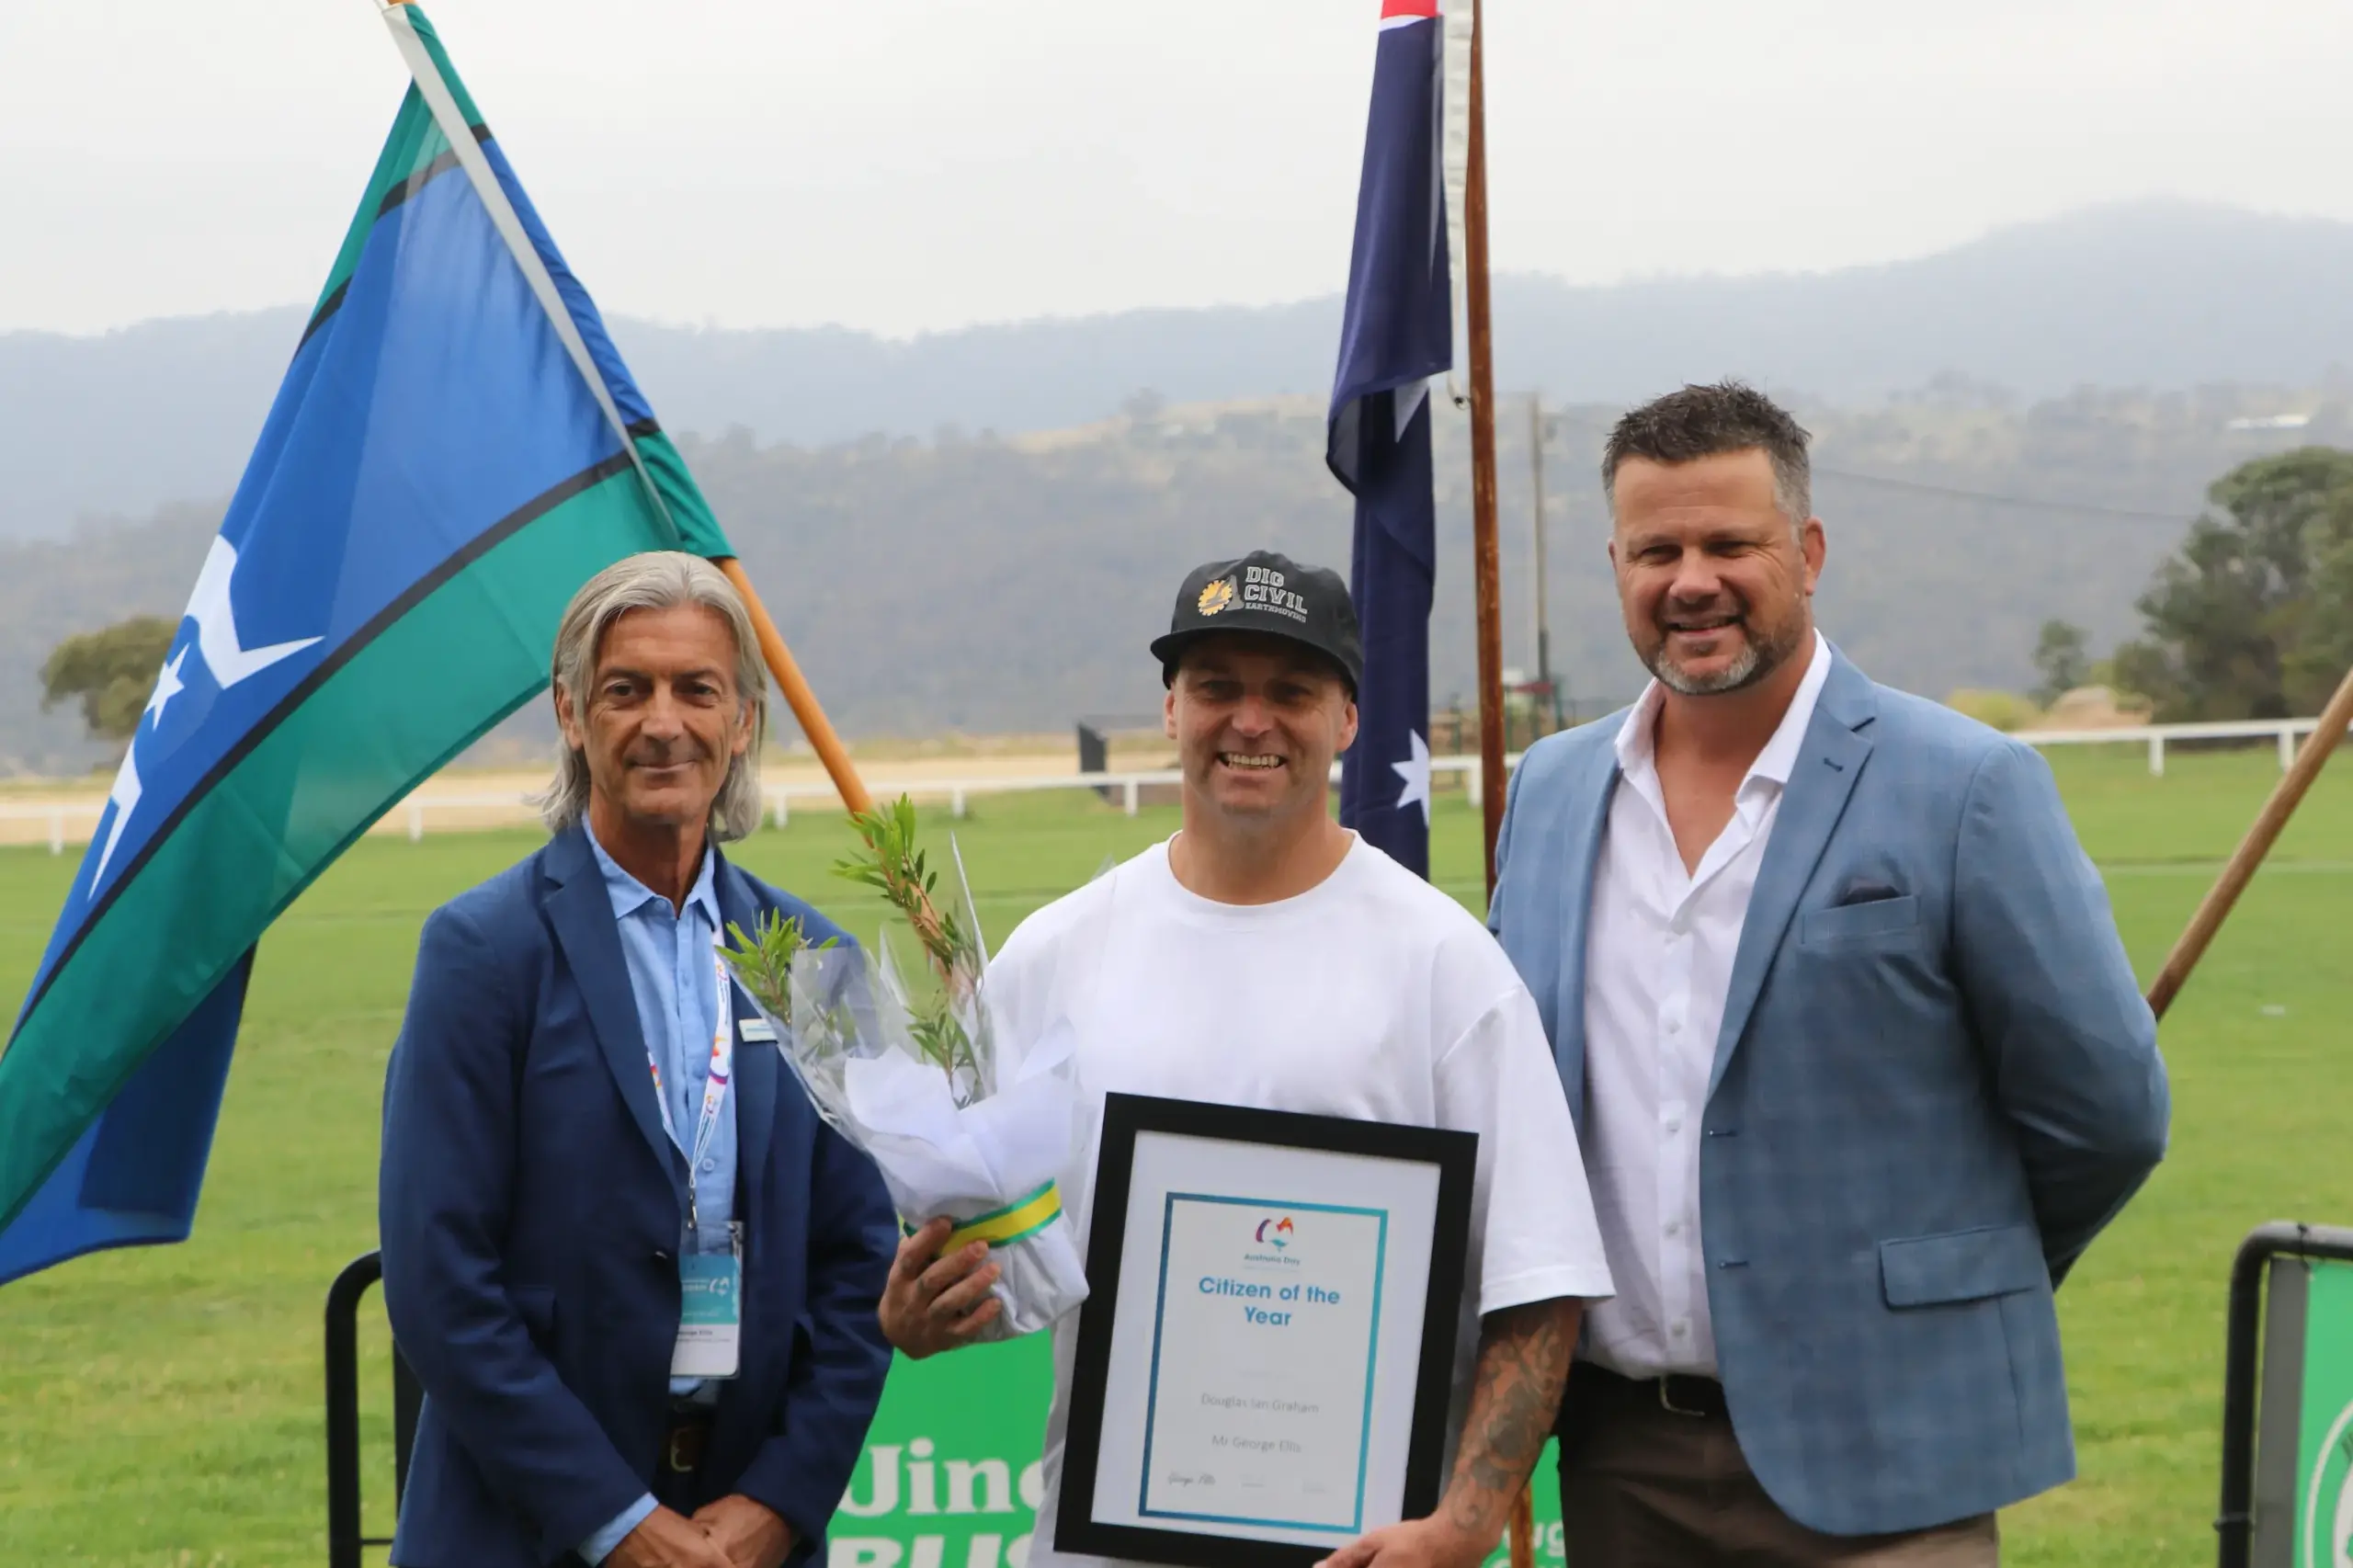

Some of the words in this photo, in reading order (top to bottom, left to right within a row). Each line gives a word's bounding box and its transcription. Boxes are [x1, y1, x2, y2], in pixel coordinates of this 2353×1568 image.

[1245, 566, 1284, 587] DIG
[1245, 584, 1308, 615] CIVIL
[1199, 1277, 1272, 1300] Citizen
[1279, 1284, 1301, 1301] of
[1307, 1286, 1340, 1305] the
[1245, 1306, 1292, 1326] Year
